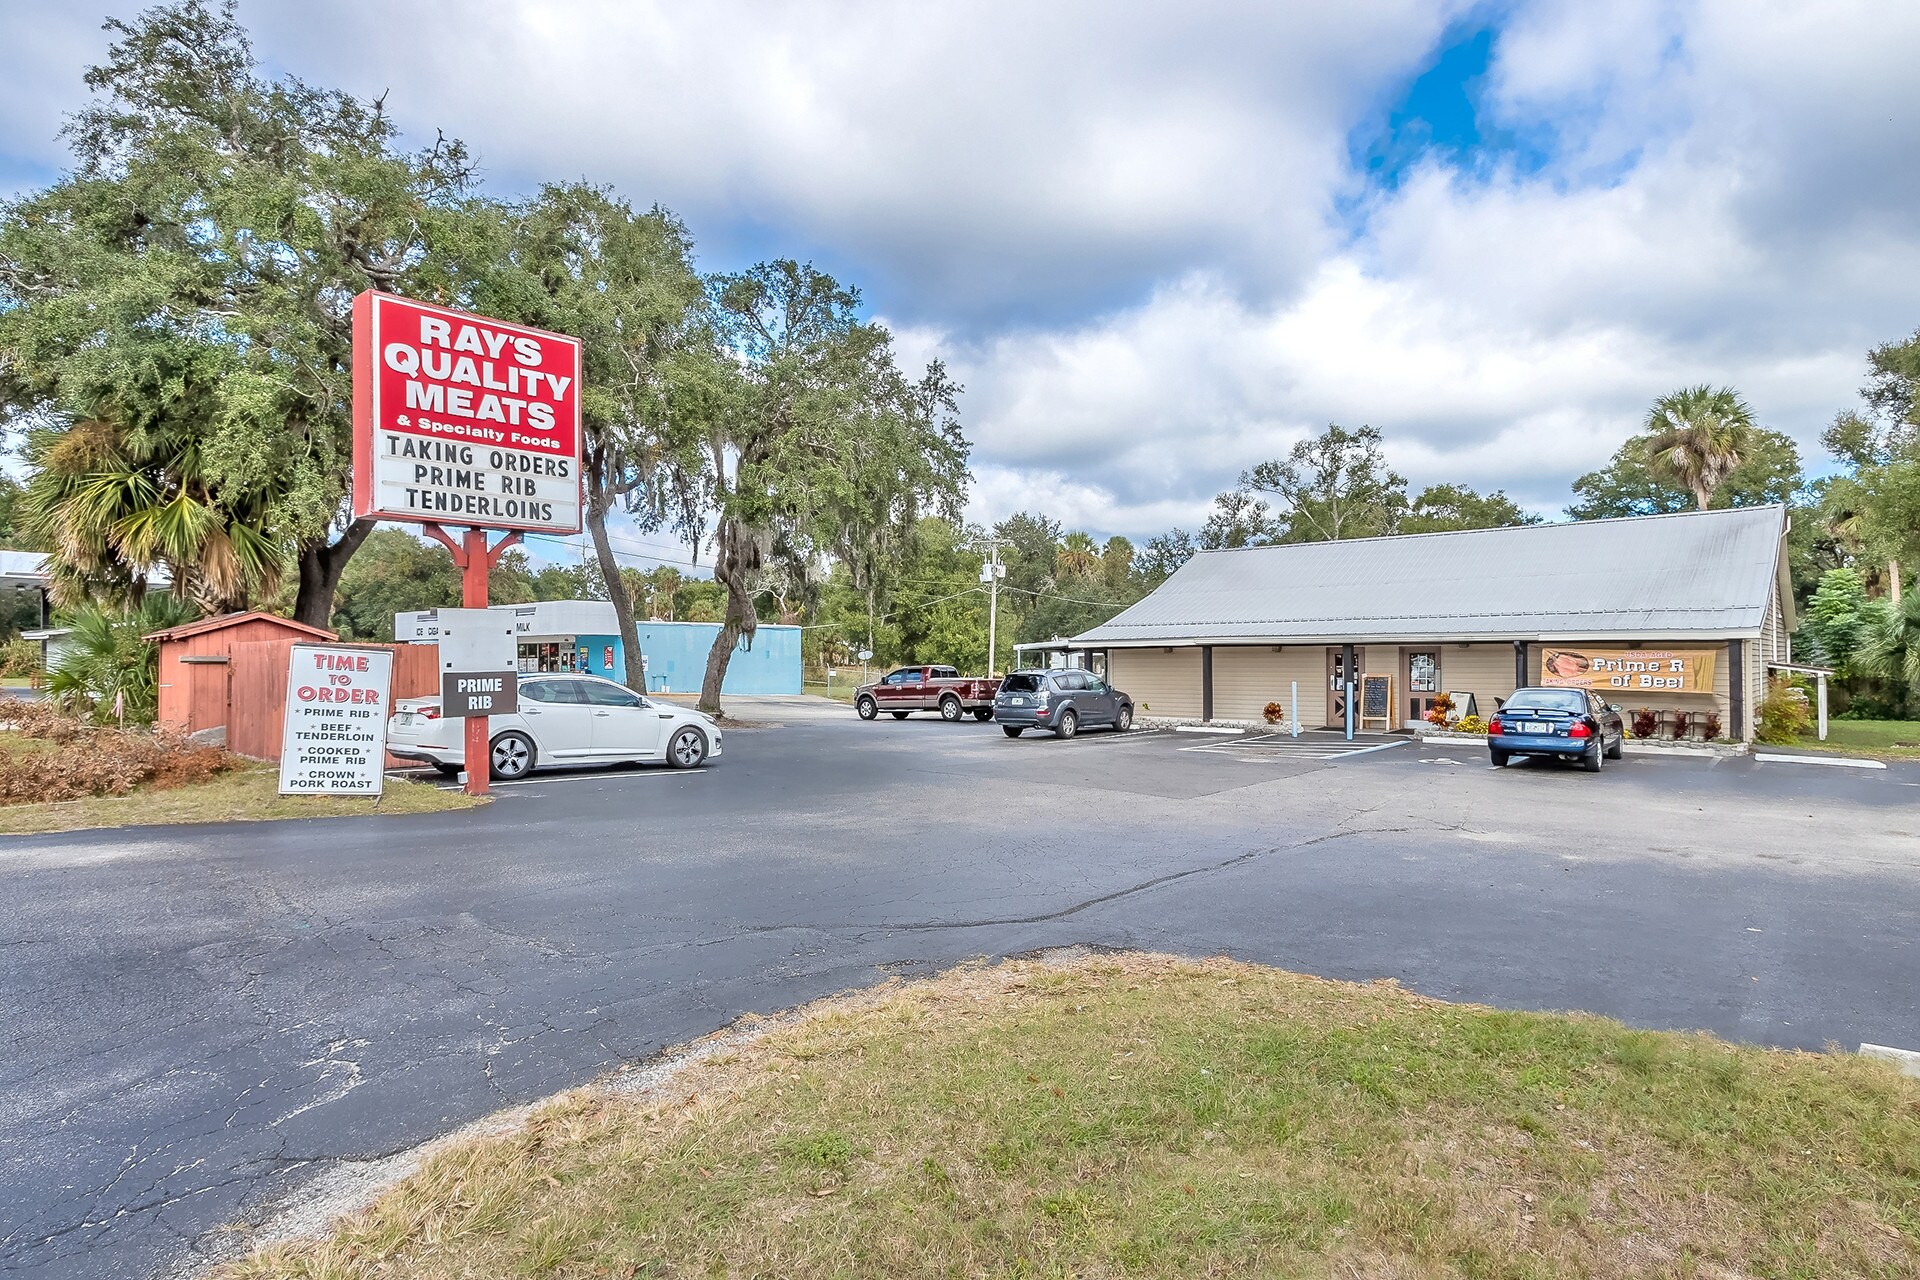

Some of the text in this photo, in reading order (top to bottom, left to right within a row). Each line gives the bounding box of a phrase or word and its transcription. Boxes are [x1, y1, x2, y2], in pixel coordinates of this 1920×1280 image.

[420, 315, 543, 367] RAY'S
[384, 343, 572, 401] QUALITY
[406, 379, 555, 430] MEATS
[397, 415, 560, 449] & Specialty Foods
[387, 435, 569, 478] TAKING ORDERS
[415, 464, 536, 496] PRIME RIB
[406, 488, 552, 521] TENDERLOINS
[416, 627, 424, 636] ICE
[516, 622, 530, 632] MILK
[314, 654, 369, 672] TIME
[1592, 658, 1660, 672] Prime
[329, 674, 351, 685] TO
[457, 678, 502, 693] PRIME
[1611, 675, 1631, 687] of
[297, 686, 379, 705] ORDER
[468, 696, 493, 710] RIB
[304, 708, 370, 718] PRIME RIB
[321, 723, 352, 732] BEEF
[296, 732, 374, 741] TENDERLOIN
[308, 746, 360, 755] COOKED
[300, 756, 366, 765] PRIME RIB
[309, 770, 355, 779] CROWN
[290, 780, 372, 788] PORK ROAST
